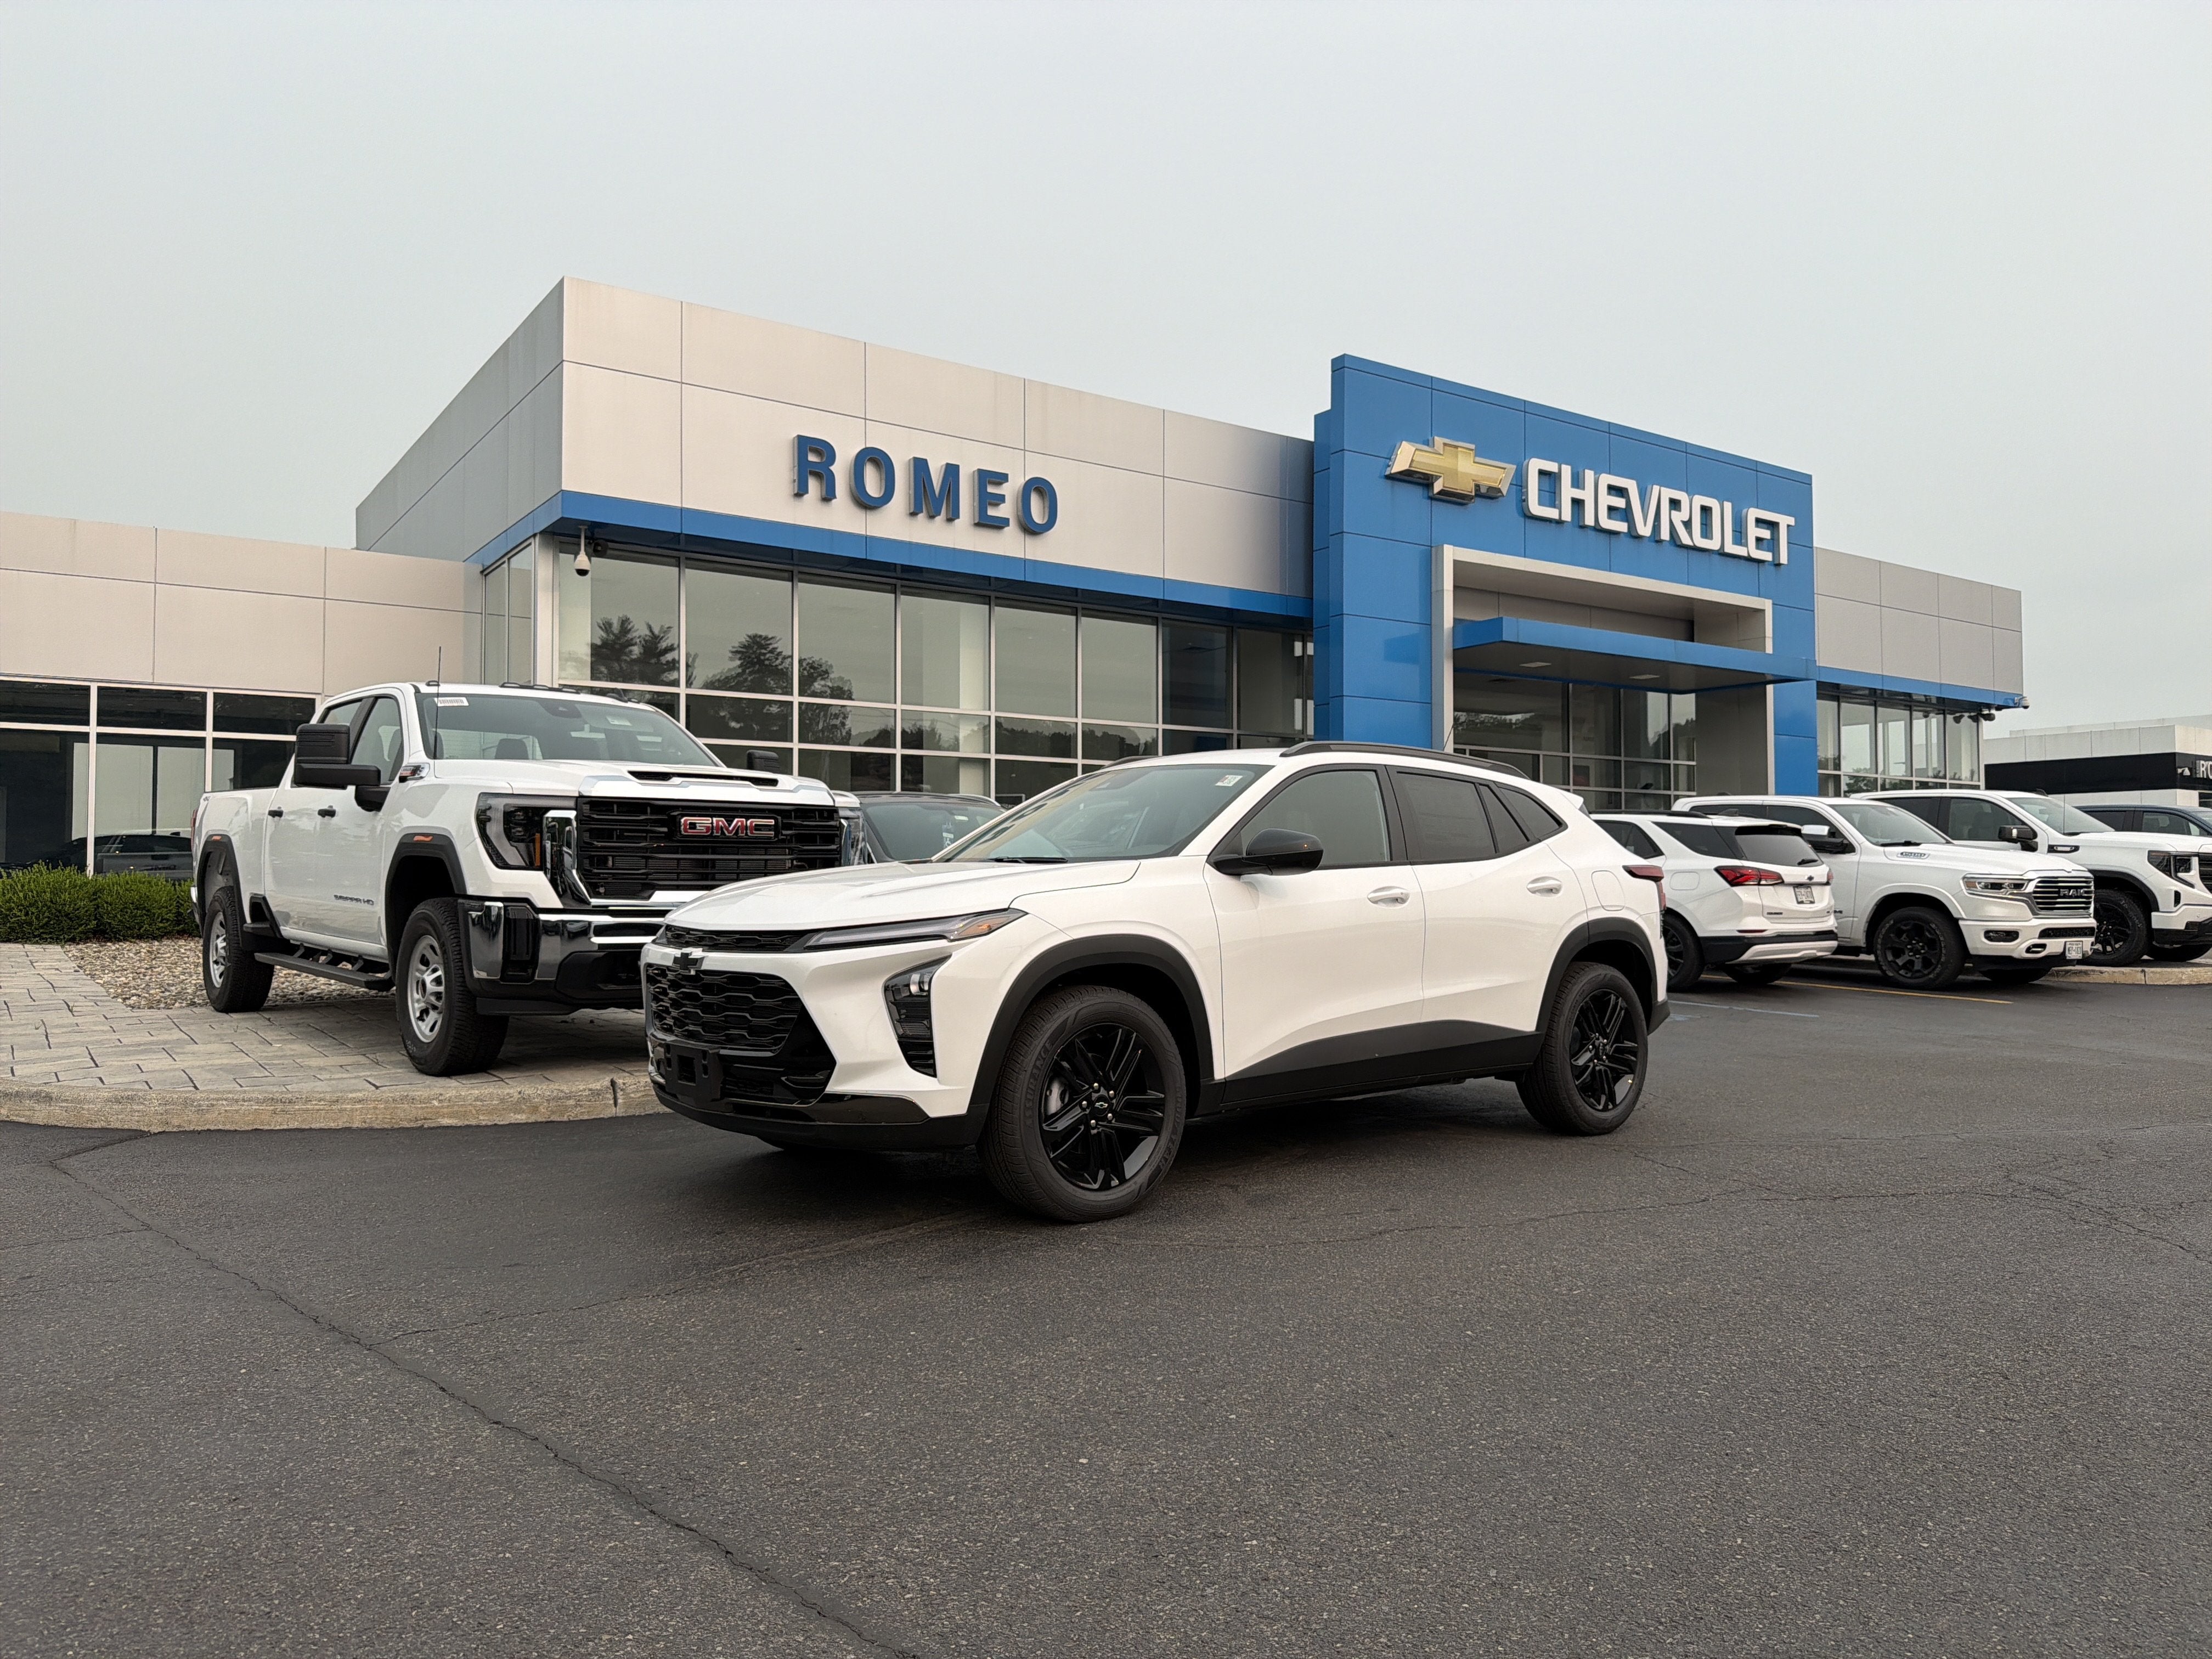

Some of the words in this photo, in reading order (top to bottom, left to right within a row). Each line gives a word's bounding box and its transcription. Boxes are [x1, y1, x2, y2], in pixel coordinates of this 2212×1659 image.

[793, 435, 1058, 534] ROMEO
[1522, 458, 1795, 565] CHEVROLET
[680, 816, 775, 838] GMC
[1024, 1039, 1053, 1130] ASSURANCE
